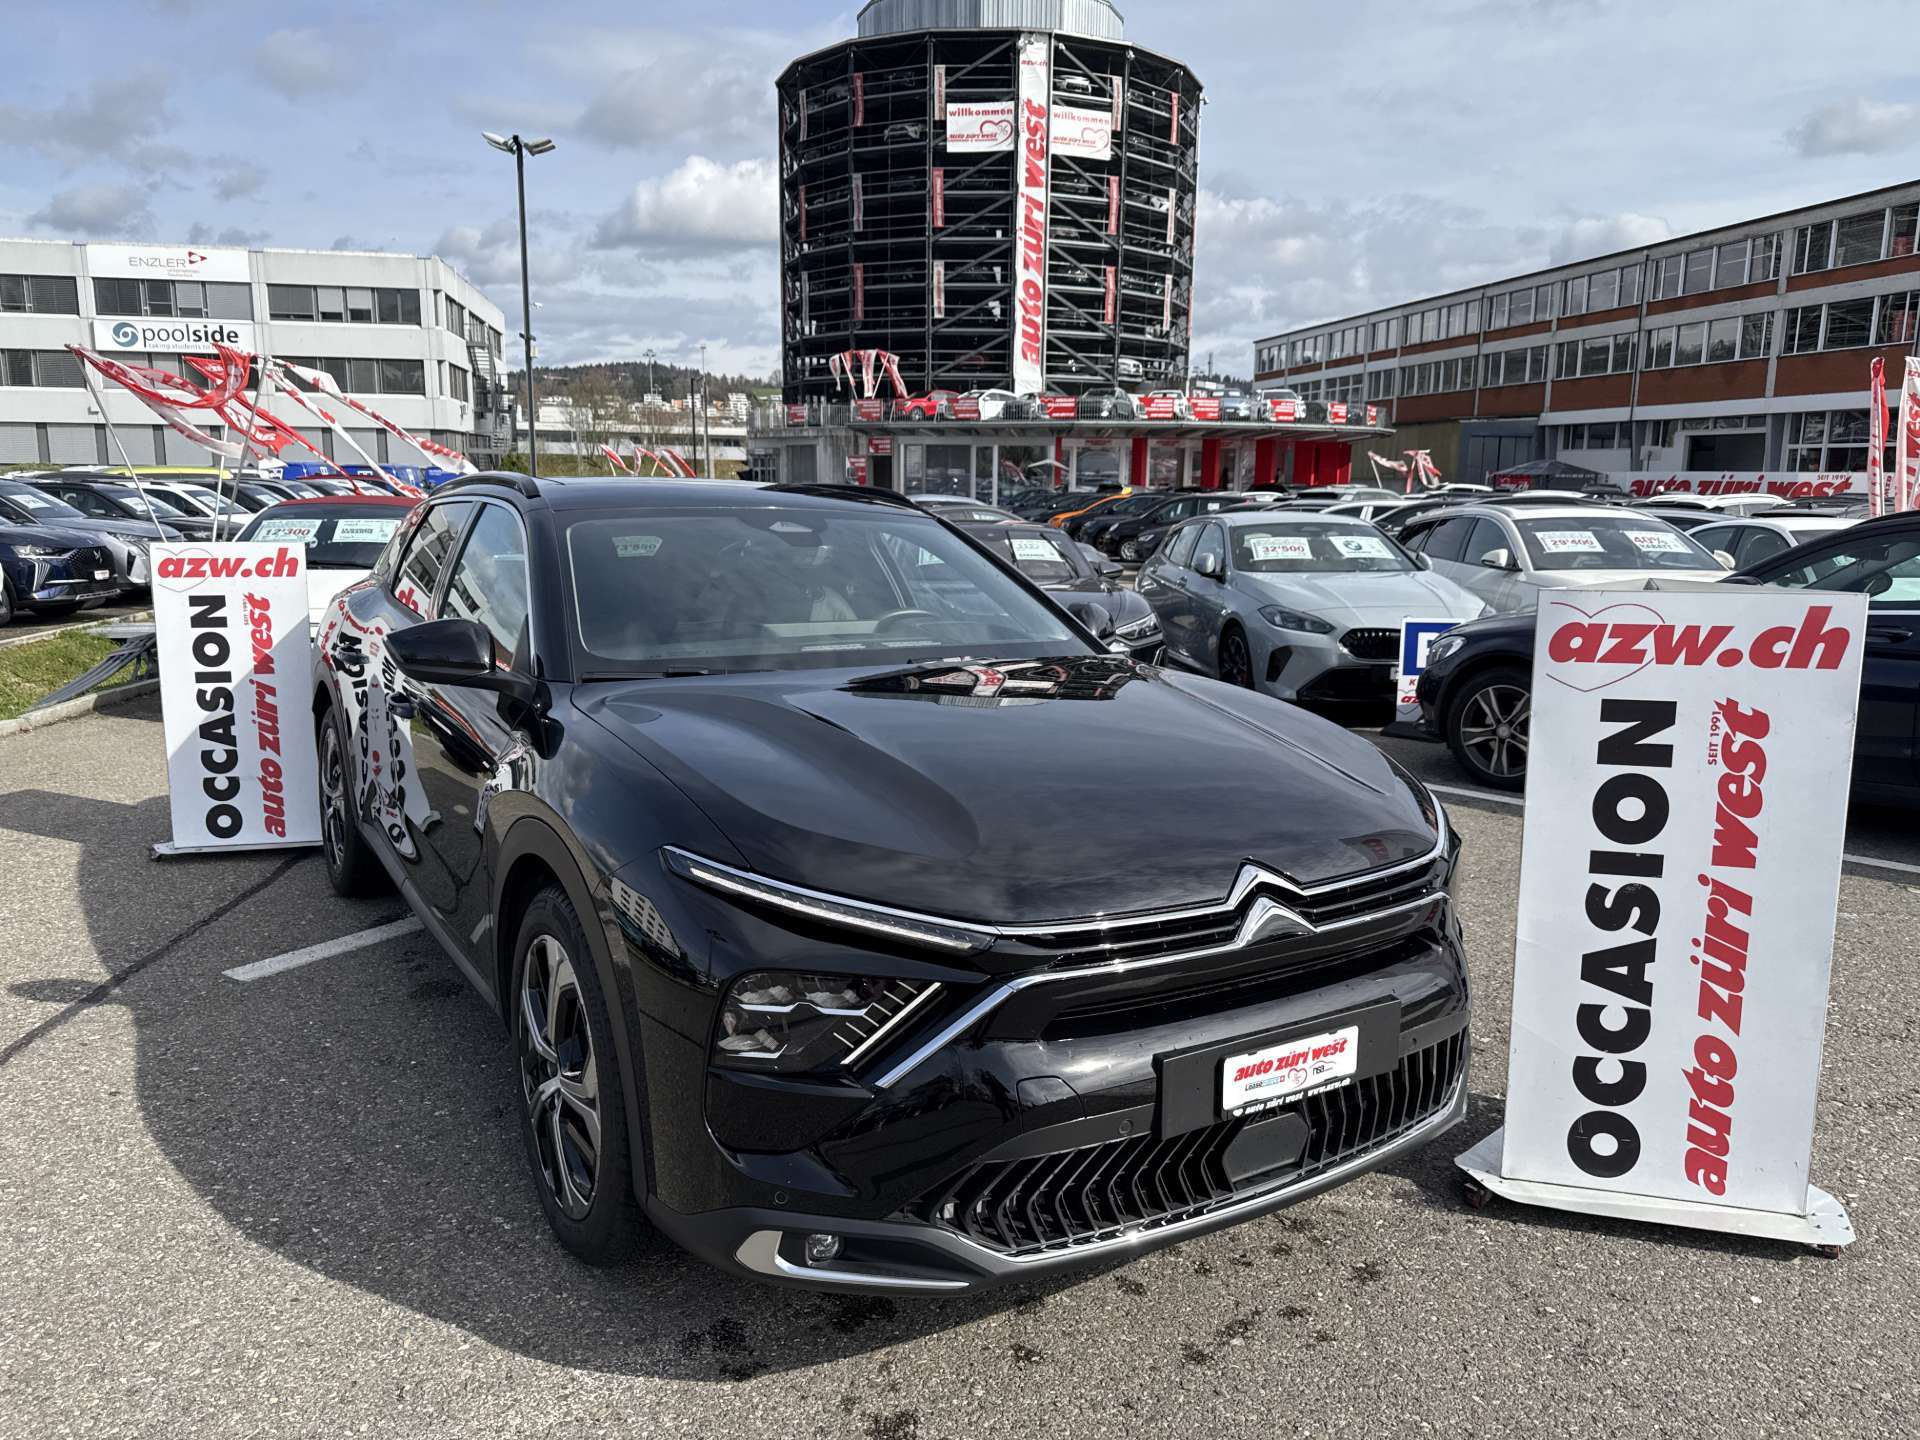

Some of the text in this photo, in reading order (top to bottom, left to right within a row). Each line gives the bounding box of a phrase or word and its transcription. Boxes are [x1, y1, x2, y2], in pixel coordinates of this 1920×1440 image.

[948, 107, 1013, 117] willkommen
[1053, 112, 1110, 125] willkommen
[1017, 98, 1047, 366] auto züri west
[128, 256, 186, 268] ENZLER
[142, 324, 239, 347] poolside
[1629, 474, 1854, 497] auto züri west
[157, 547, 299, 578] azw.ch
[1548, 605, 1851, 670] azw.ch
[188, 595, 243, 839] OCCASION
[243, 592, 287, 838] auto züri west
[1707, 710, 1722, 766] SEIT 1991
[1567, 698, 1678, 1178] OCCASION
[1681, 697, 1770, 1197] auto züri west
[1234, 1039, 1348, 1082] auto züri west
